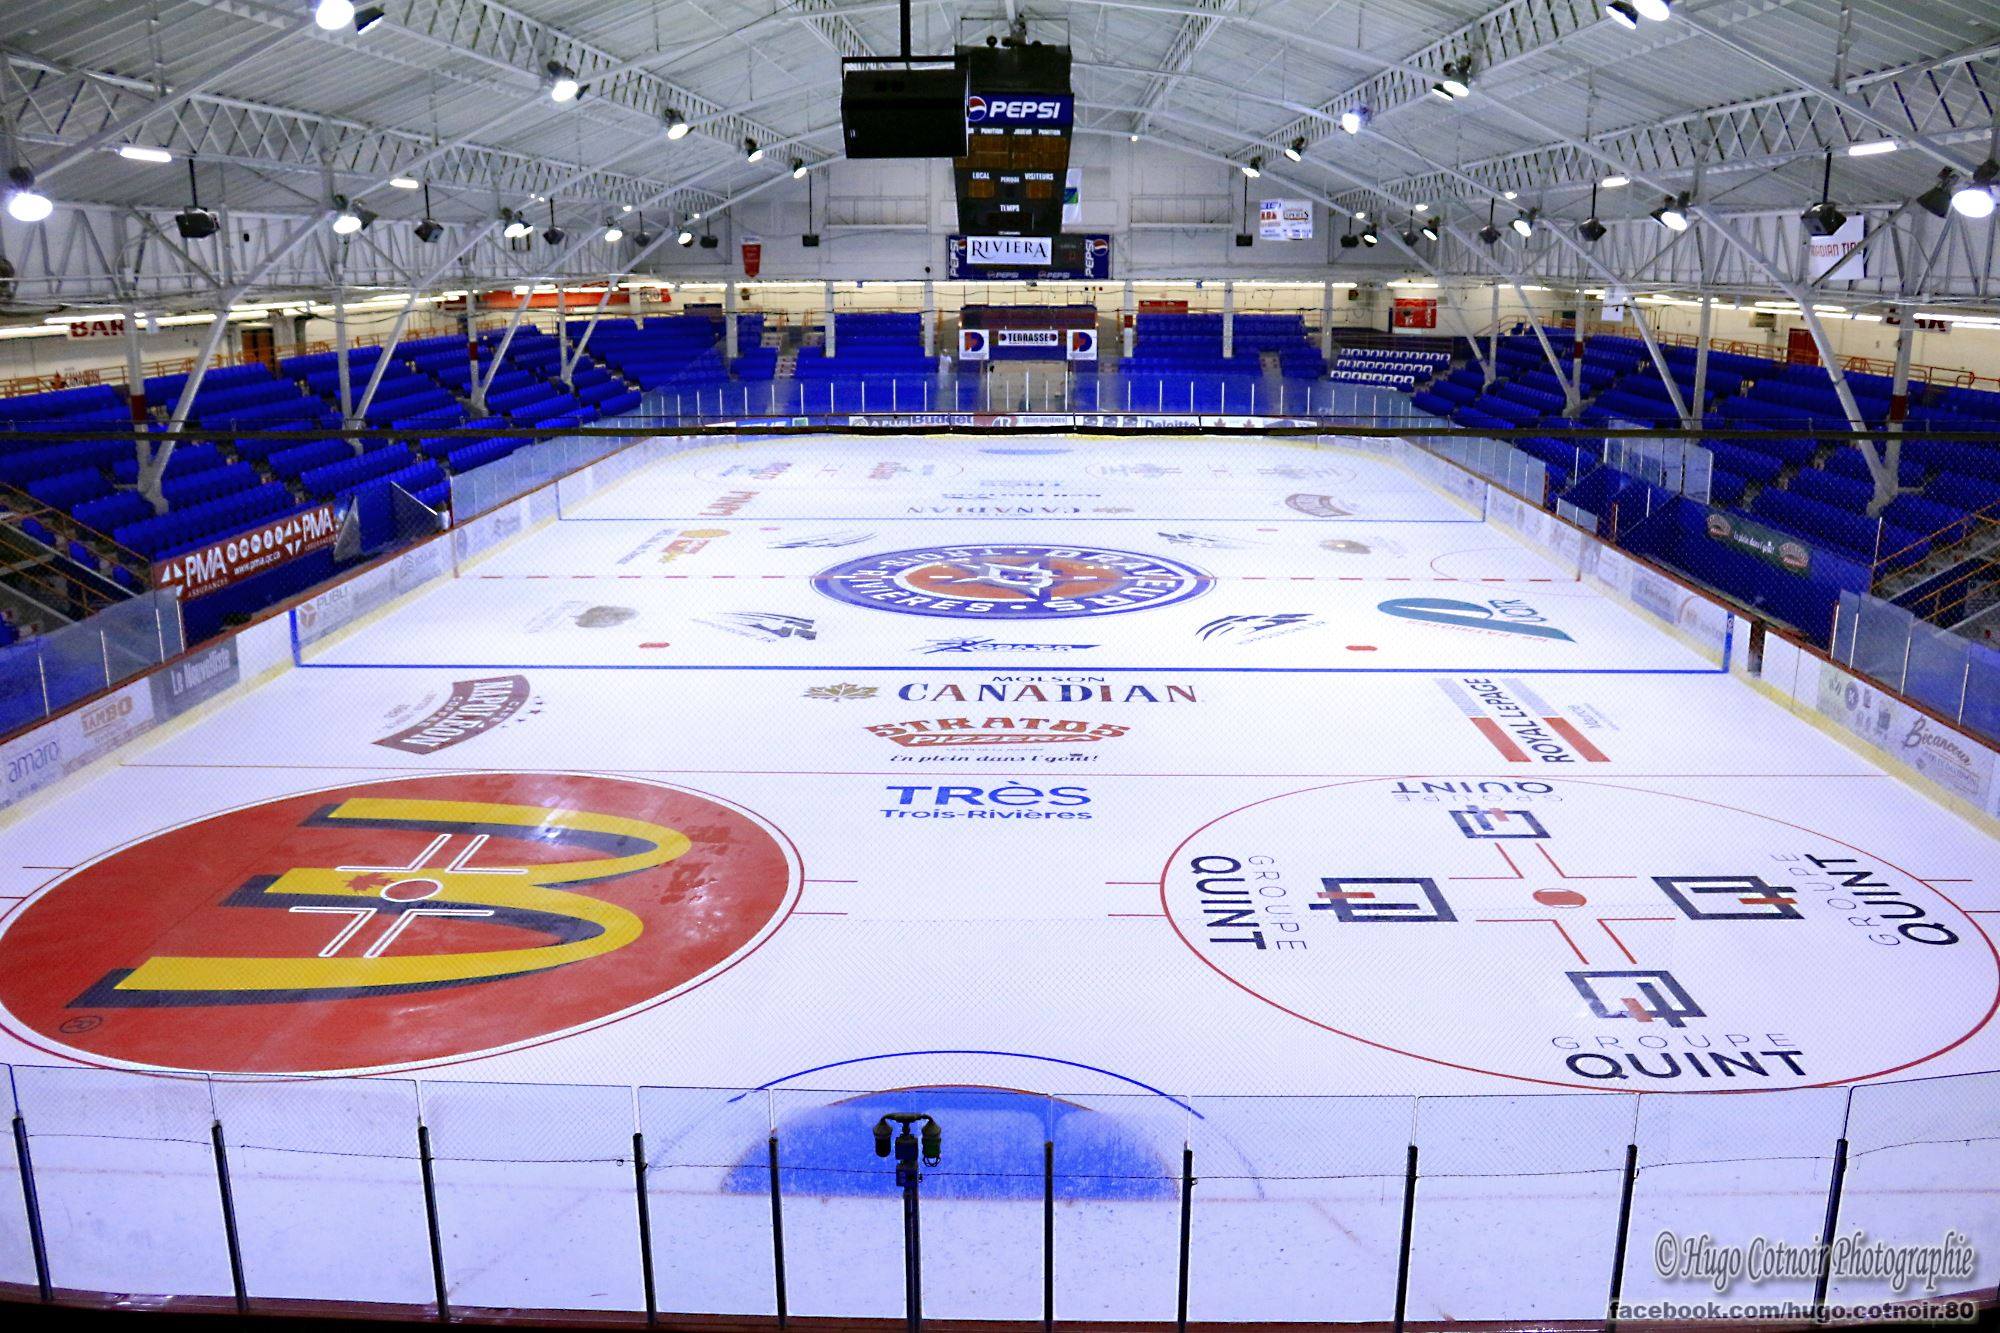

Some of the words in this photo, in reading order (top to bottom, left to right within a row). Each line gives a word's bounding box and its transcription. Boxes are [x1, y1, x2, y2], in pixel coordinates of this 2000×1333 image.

[989, 101, 1061, 119] PEPSI
[972, 172, 990, 180] LOCAL
[1024, 172, 1054, 181] VISITEURS
[1000, 204, 1020, 212] TEMPS
[971, 240, 1048, 259] RIVIERA
[1084, 239, 1096, 277] PEPSI
[1008, 332, 1050, 342] TERRASSE
[303, 508, 334, 542] PMA
[185, 546, 227, 588] PMA
[898, 683, 1199, 703] CANADIAN
[1463, 678, 1528, 717] LEPAGE
[865, 717, 1132, 739] STRATOS
[1509, 720, 1575, 762] ROYAL
[7, 740, 60, 782] amaro
[918, 754, 972, 763] plein
[977, 755, 1026, 763] dans
[1391, 781, 1555, 793] QUINT
[879, 809, 1093, 820] Trois-Rivières
[1190, 855, 1267, 950] QUINT
[1248, 855, 1307, 950] GROUPE
[1770, 853, 1900, 946] GROUPE
[1804, 853, 1960, 946] QUINT
[1551, 1033, 1797, 1050] GROUPE
[1565, 1050, 1807, 1080] QUINT
